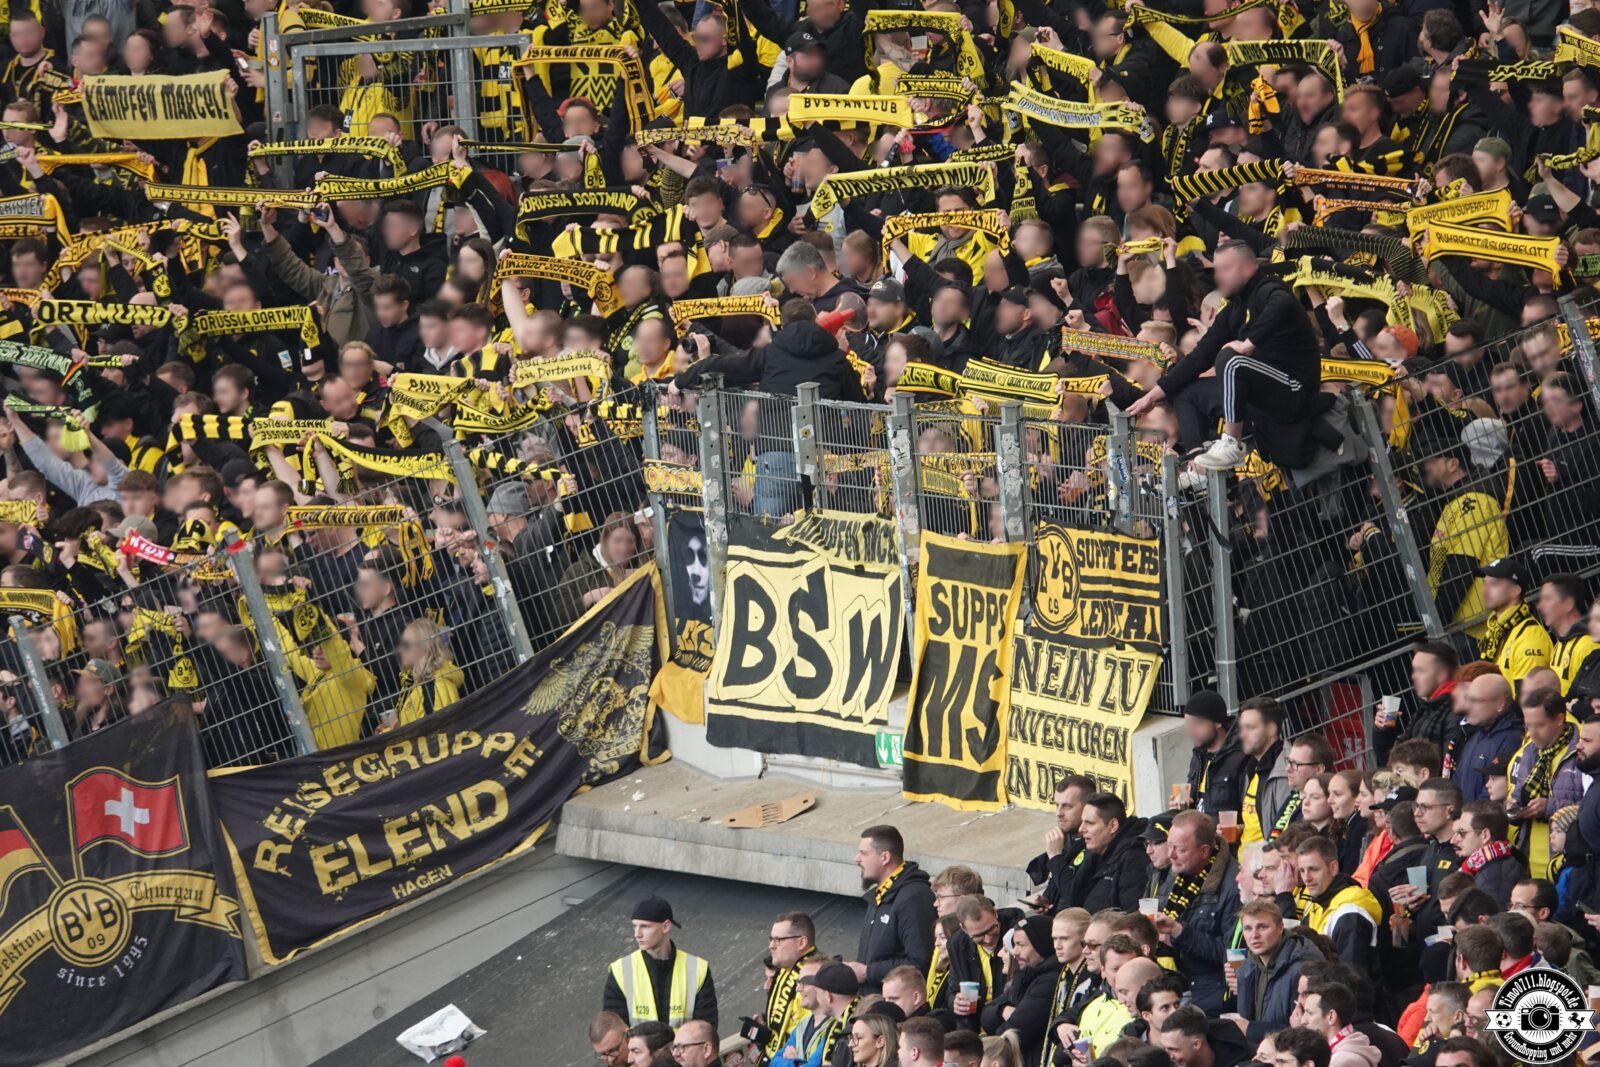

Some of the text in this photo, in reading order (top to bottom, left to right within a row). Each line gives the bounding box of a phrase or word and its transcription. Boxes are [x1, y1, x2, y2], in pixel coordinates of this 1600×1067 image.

[957, 50, 975, 66] BVB
[804, 97, 897, 114] BVB FANCLUB
[815, 187, 833, 209] BVB
[827, 175, 907, 199] BORUSSIA
[517, 191, 638, 217] BORUSSIA DORTMUND
[303, 323, 317, 339] BVB
[537, 361, 592, 379] Dortmund
[1038, 539, 1074, 600] BVB
[722, 565, 901, 714] BSW
[1524, 649, 1544, 657] GLS.
[177, 659, 194, 676] BVB
[1010, 634, 1154, 715] NEIN ZU
[1009, 706, 1128, 766] INVESTOREN
[1007, 753, 1031, 799] IN
[253, 730, 544, 877] REISEGRUPPE
[309, 779, 509, 897] ELEND
[129, 880, 204, 903] Thurgau
[392, 864, 454, 899] HAGEN
[60, 892, 118, 943] BVB
[0, 928, 46, 979] ektion
[87, 933, 106, 951] 09
[57, 935, 148, 988] since 1995
